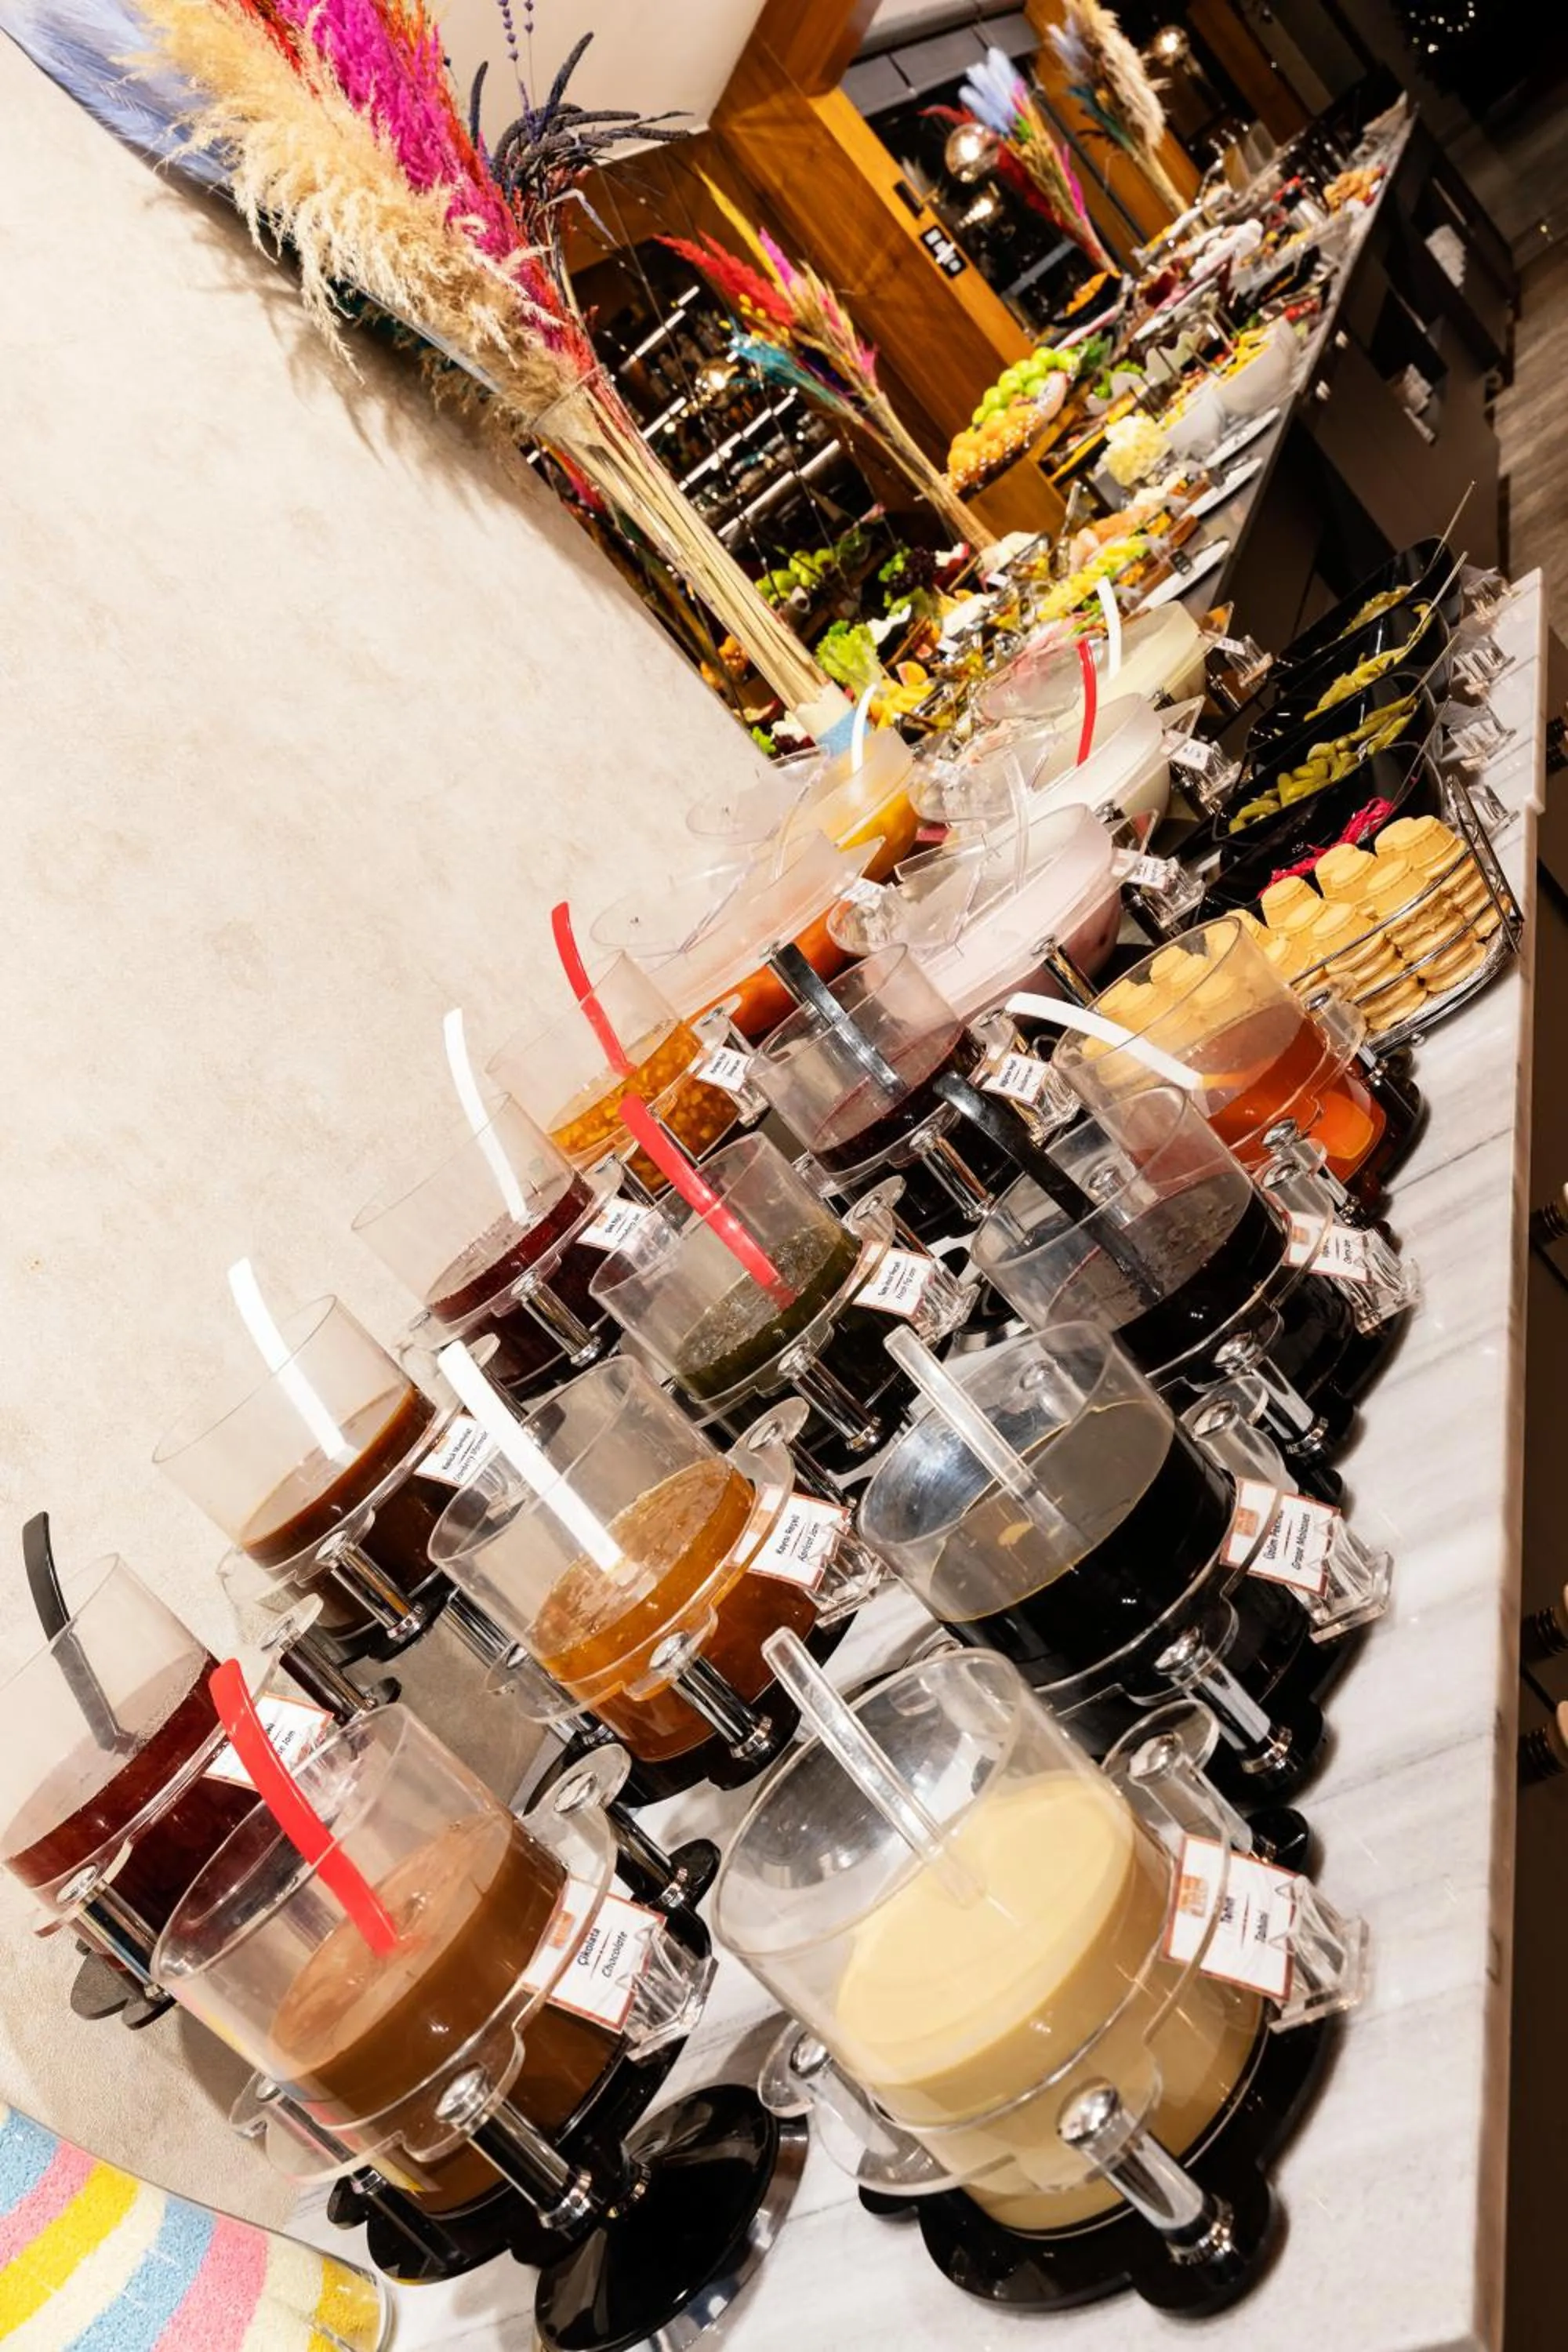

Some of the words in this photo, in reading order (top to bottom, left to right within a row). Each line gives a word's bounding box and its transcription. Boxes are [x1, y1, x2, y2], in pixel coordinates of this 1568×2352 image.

[1296, 1512, 1311, 1546] Molasses
[797, 1536, 815, 1562] Apricot
[1291, 1547, 1305, 1570] Grape
[1220, 1896, 1236, 1924] Tahin
[1255, 1911, 1269, 1943] Tahini
[577, 1927, 601, 1966] Çikolata
[601, 1930, 628, 1978] Chocolate
